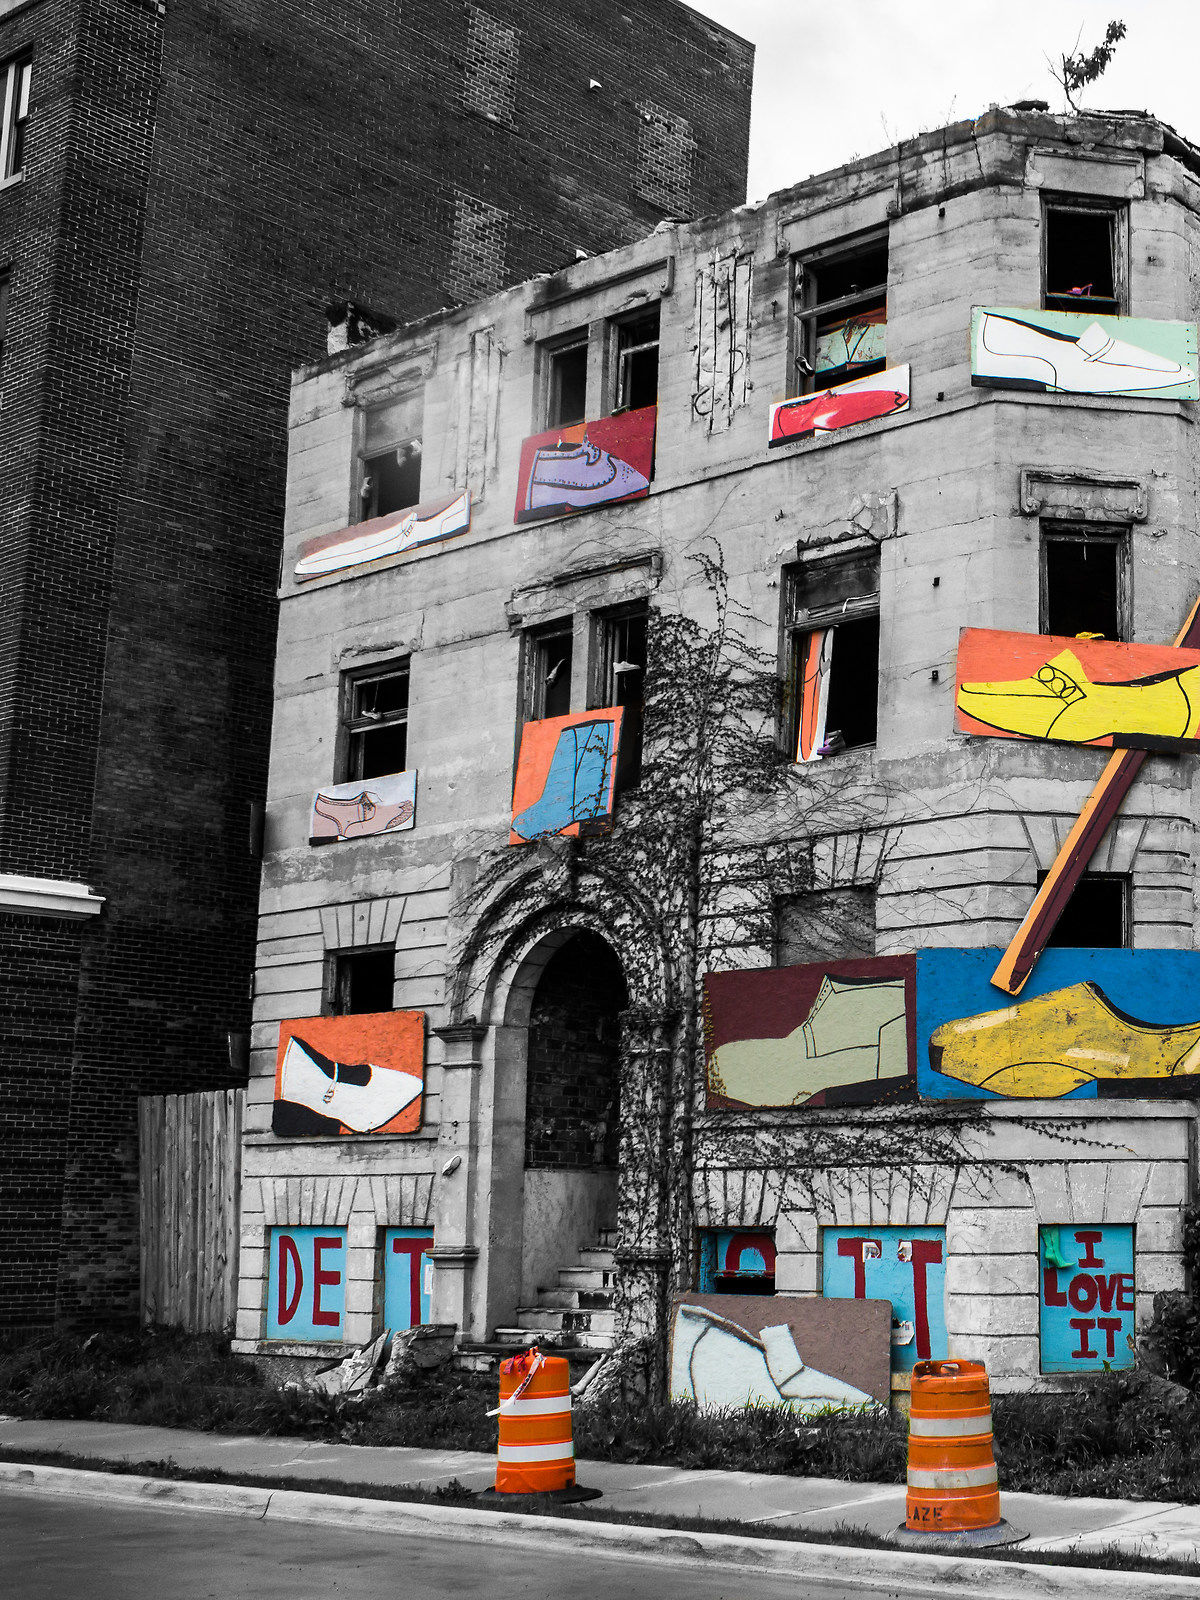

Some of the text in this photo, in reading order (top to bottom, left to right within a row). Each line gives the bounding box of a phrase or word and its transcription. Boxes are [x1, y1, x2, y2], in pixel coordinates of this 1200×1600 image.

[1074, 1231, 1105, 1268] I
[1043, 1267, 1134, 1313] LOVE
[1069, 1317, 1123, 1359] IT
